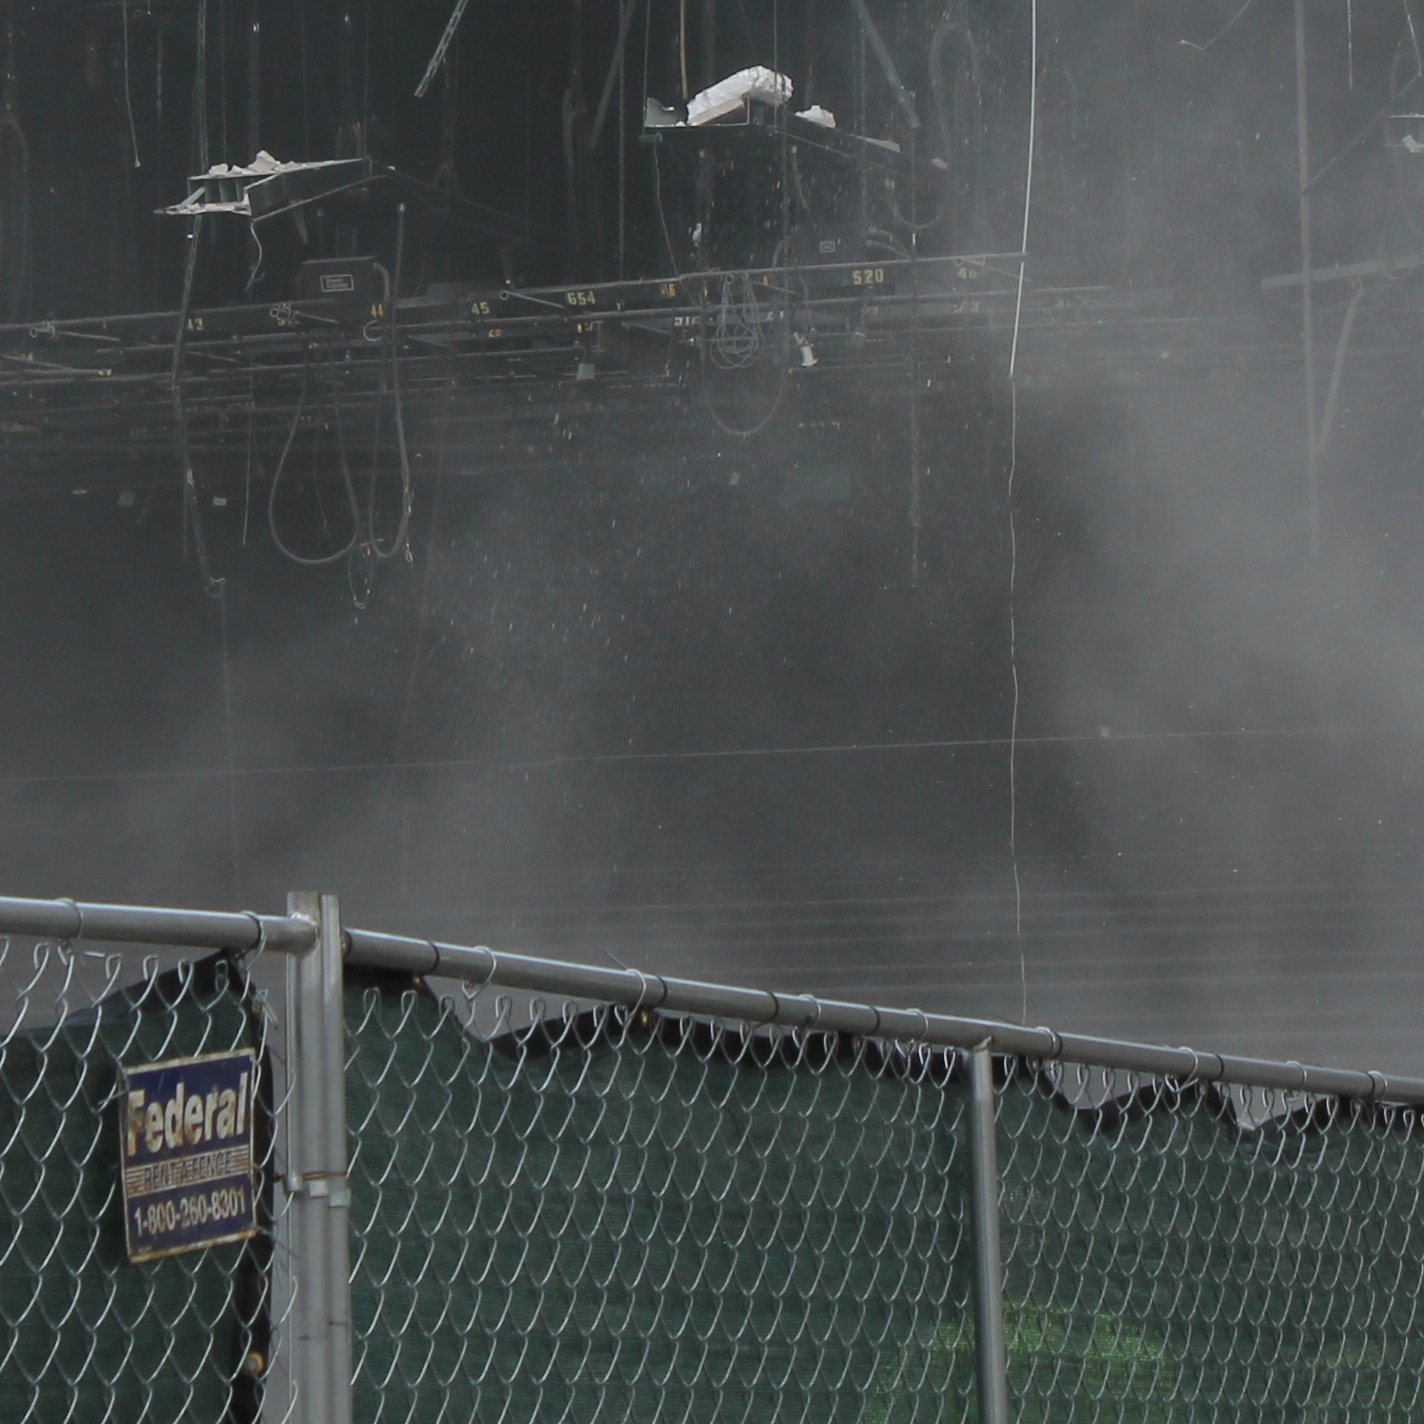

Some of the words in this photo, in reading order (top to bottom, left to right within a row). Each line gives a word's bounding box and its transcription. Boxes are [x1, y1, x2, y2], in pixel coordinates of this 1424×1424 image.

[853, 268, 884, 286] 520
[566, 291, 595, 306] 654
[471, 301, 490, 315] 45
[128, 1072, 249, 1156] Federal
[134, 1188, 246, 1236] 1-800-260-8301
